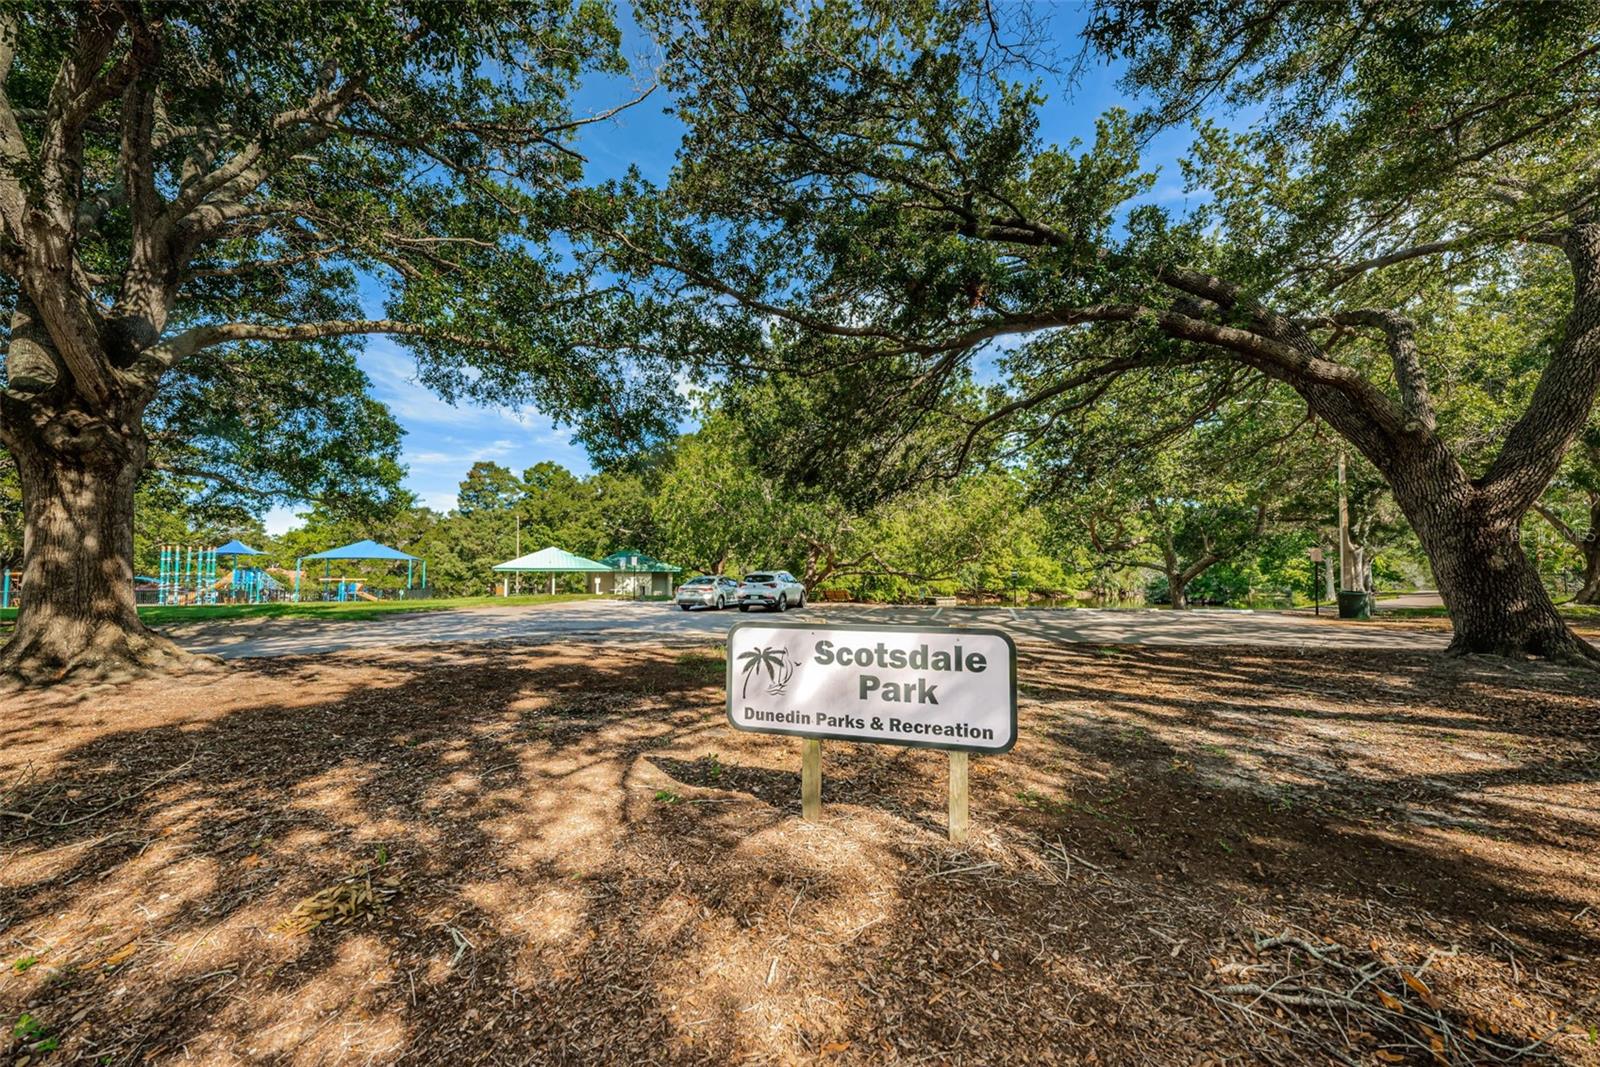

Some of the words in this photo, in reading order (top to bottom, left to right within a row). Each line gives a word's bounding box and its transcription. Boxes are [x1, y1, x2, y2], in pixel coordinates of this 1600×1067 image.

[814, 640, 988, 673] Scotsdale
[858, 674, 939, 705] Park
[743, 707, 811, 725] Dunedin
[816, 712, 865, 730] Parks
[870, 716, 884, 731] &
[889, 718, 994, 740] Recreation
